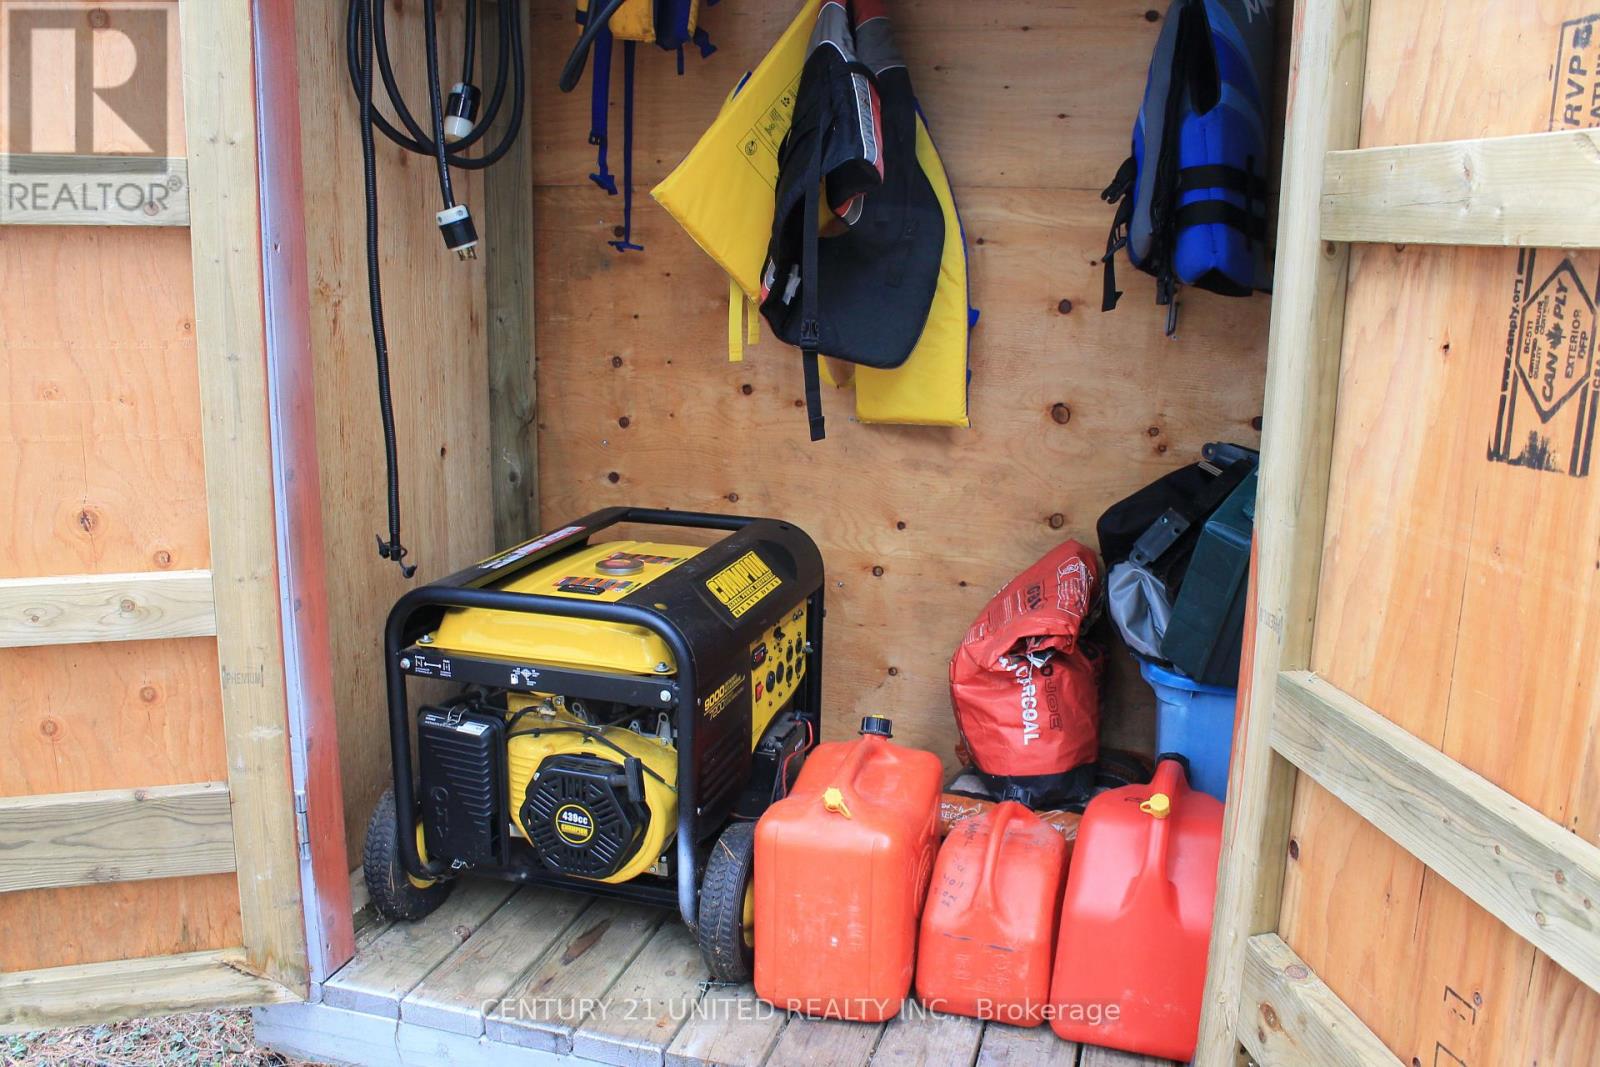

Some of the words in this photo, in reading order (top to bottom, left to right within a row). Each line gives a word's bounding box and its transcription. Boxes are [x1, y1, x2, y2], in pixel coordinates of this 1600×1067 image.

[1542, 352, 1559, 402] CAN
[1553, 277, 1569, 321] PLY
[1564, 309, 1582, 379] EXTERIOR
[707, 553, 769, 603] CHAMPION
[704, 685, 725, 712] 9000
[562, 811, 588, 825] 439cc
